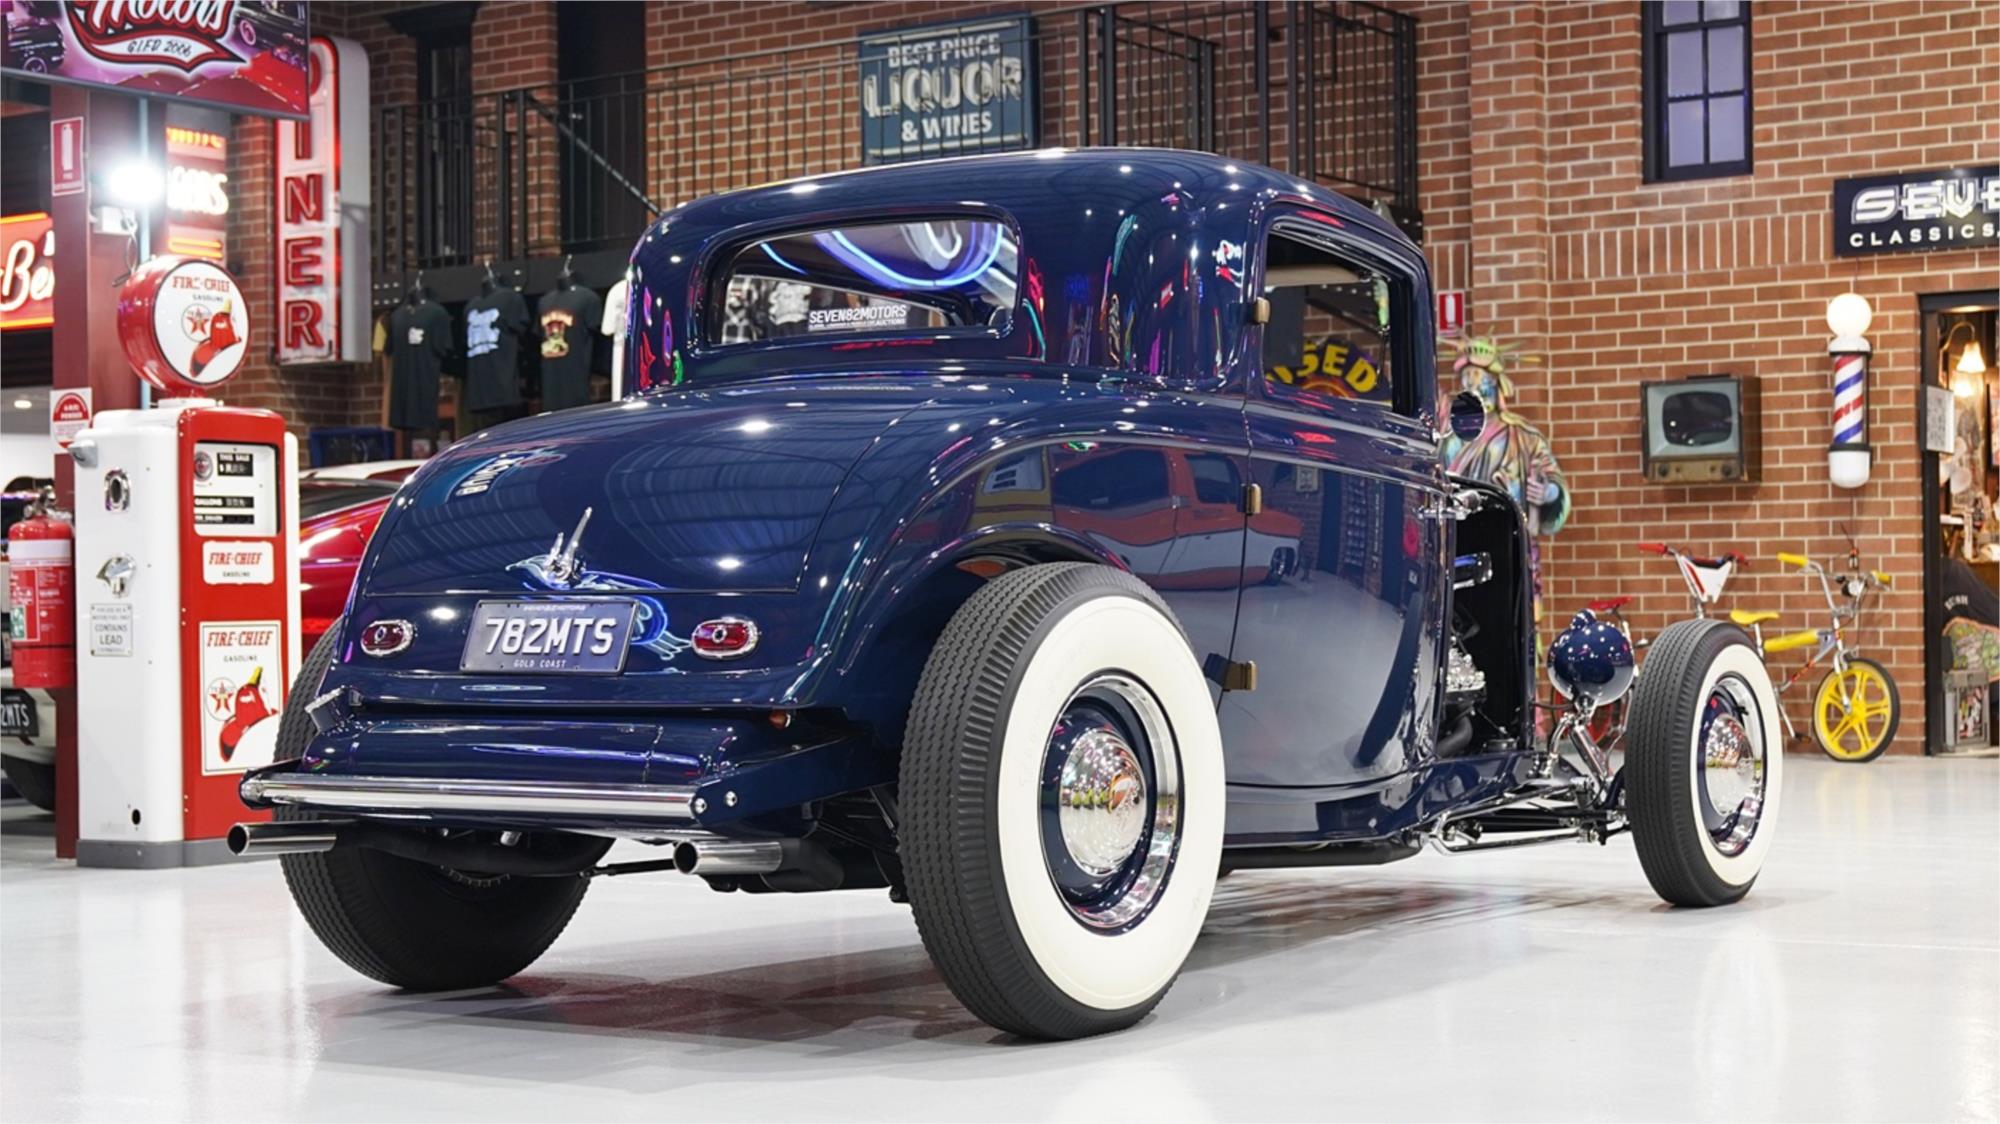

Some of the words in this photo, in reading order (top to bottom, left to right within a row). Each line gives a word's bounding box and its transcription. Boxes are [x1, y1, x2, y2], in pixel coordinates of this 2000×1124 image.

[888, 42, 937, 68] BEST
[940, 33, 1001, 61] PRICE
[863, 56, 1022, 118] LIQUOR
[901, 120, 919, 142] &
[921, 111, 993, 139] WINES
[809, 304, 907, 324] SEVEN82MOTORS
[208, 551, 263, 566] FIRE-CHIEF
[99, 634, 124, 646] LEAD
[206, 630, 274, 648] FIRE-CHIEF
[486, 617, 617, 655] 782MTS
[513, 659, 535, 668] GOLD
[539, 659, 567, 669] COAST
